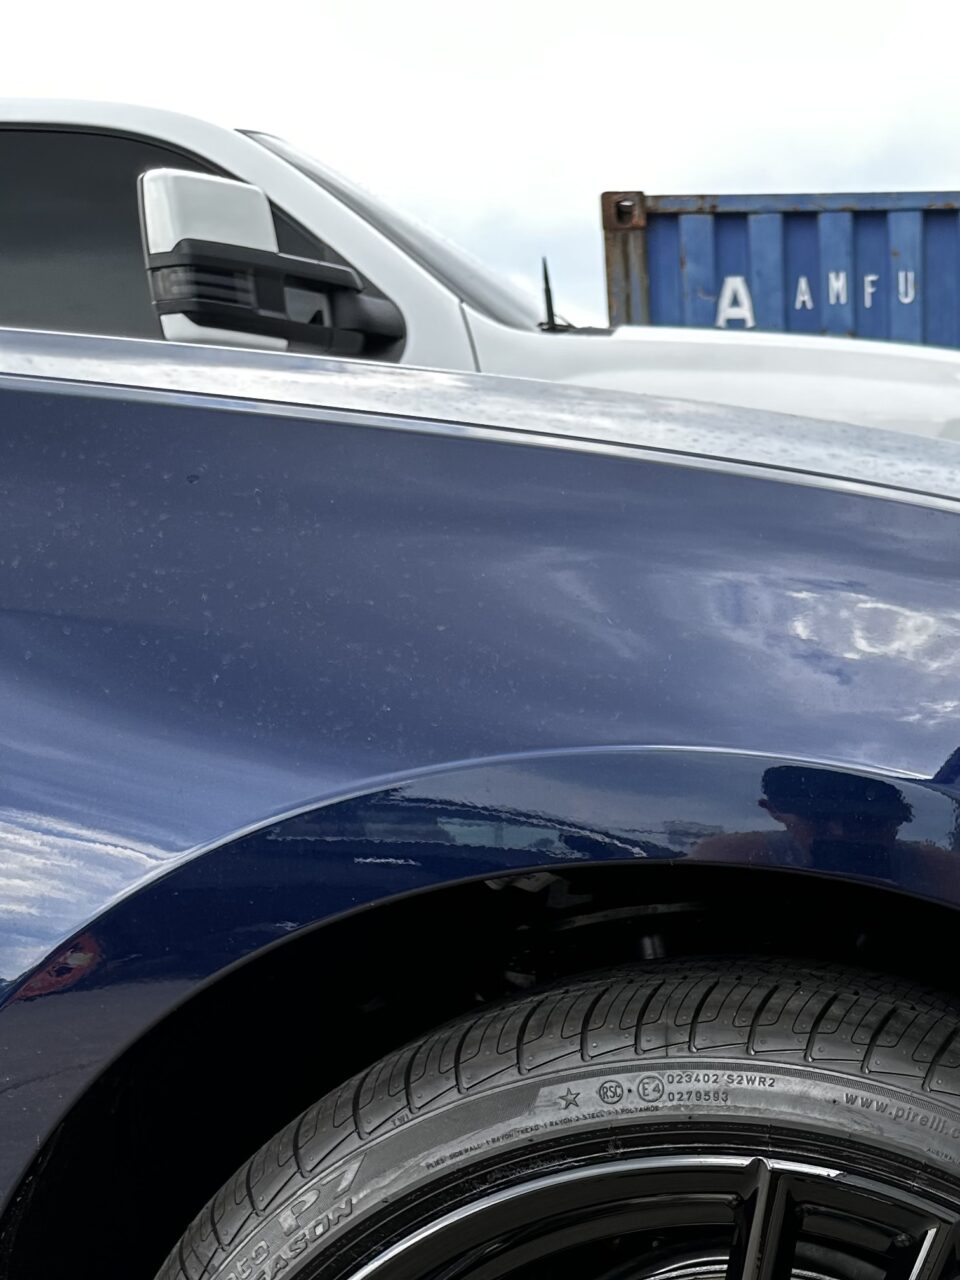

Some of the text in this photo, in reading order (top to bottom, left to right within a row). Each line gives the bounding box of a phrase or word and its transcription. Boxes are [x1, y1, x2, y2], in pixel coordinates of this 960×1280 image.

[714, 275, 756, 329] A
[795, 271, 916, 310] AMFU
[601, 1085, 622, 1101] RSC
[667, 1073, 777, 1088] 023402 S2WR2
[277, 1151, 368, 1238] P7
